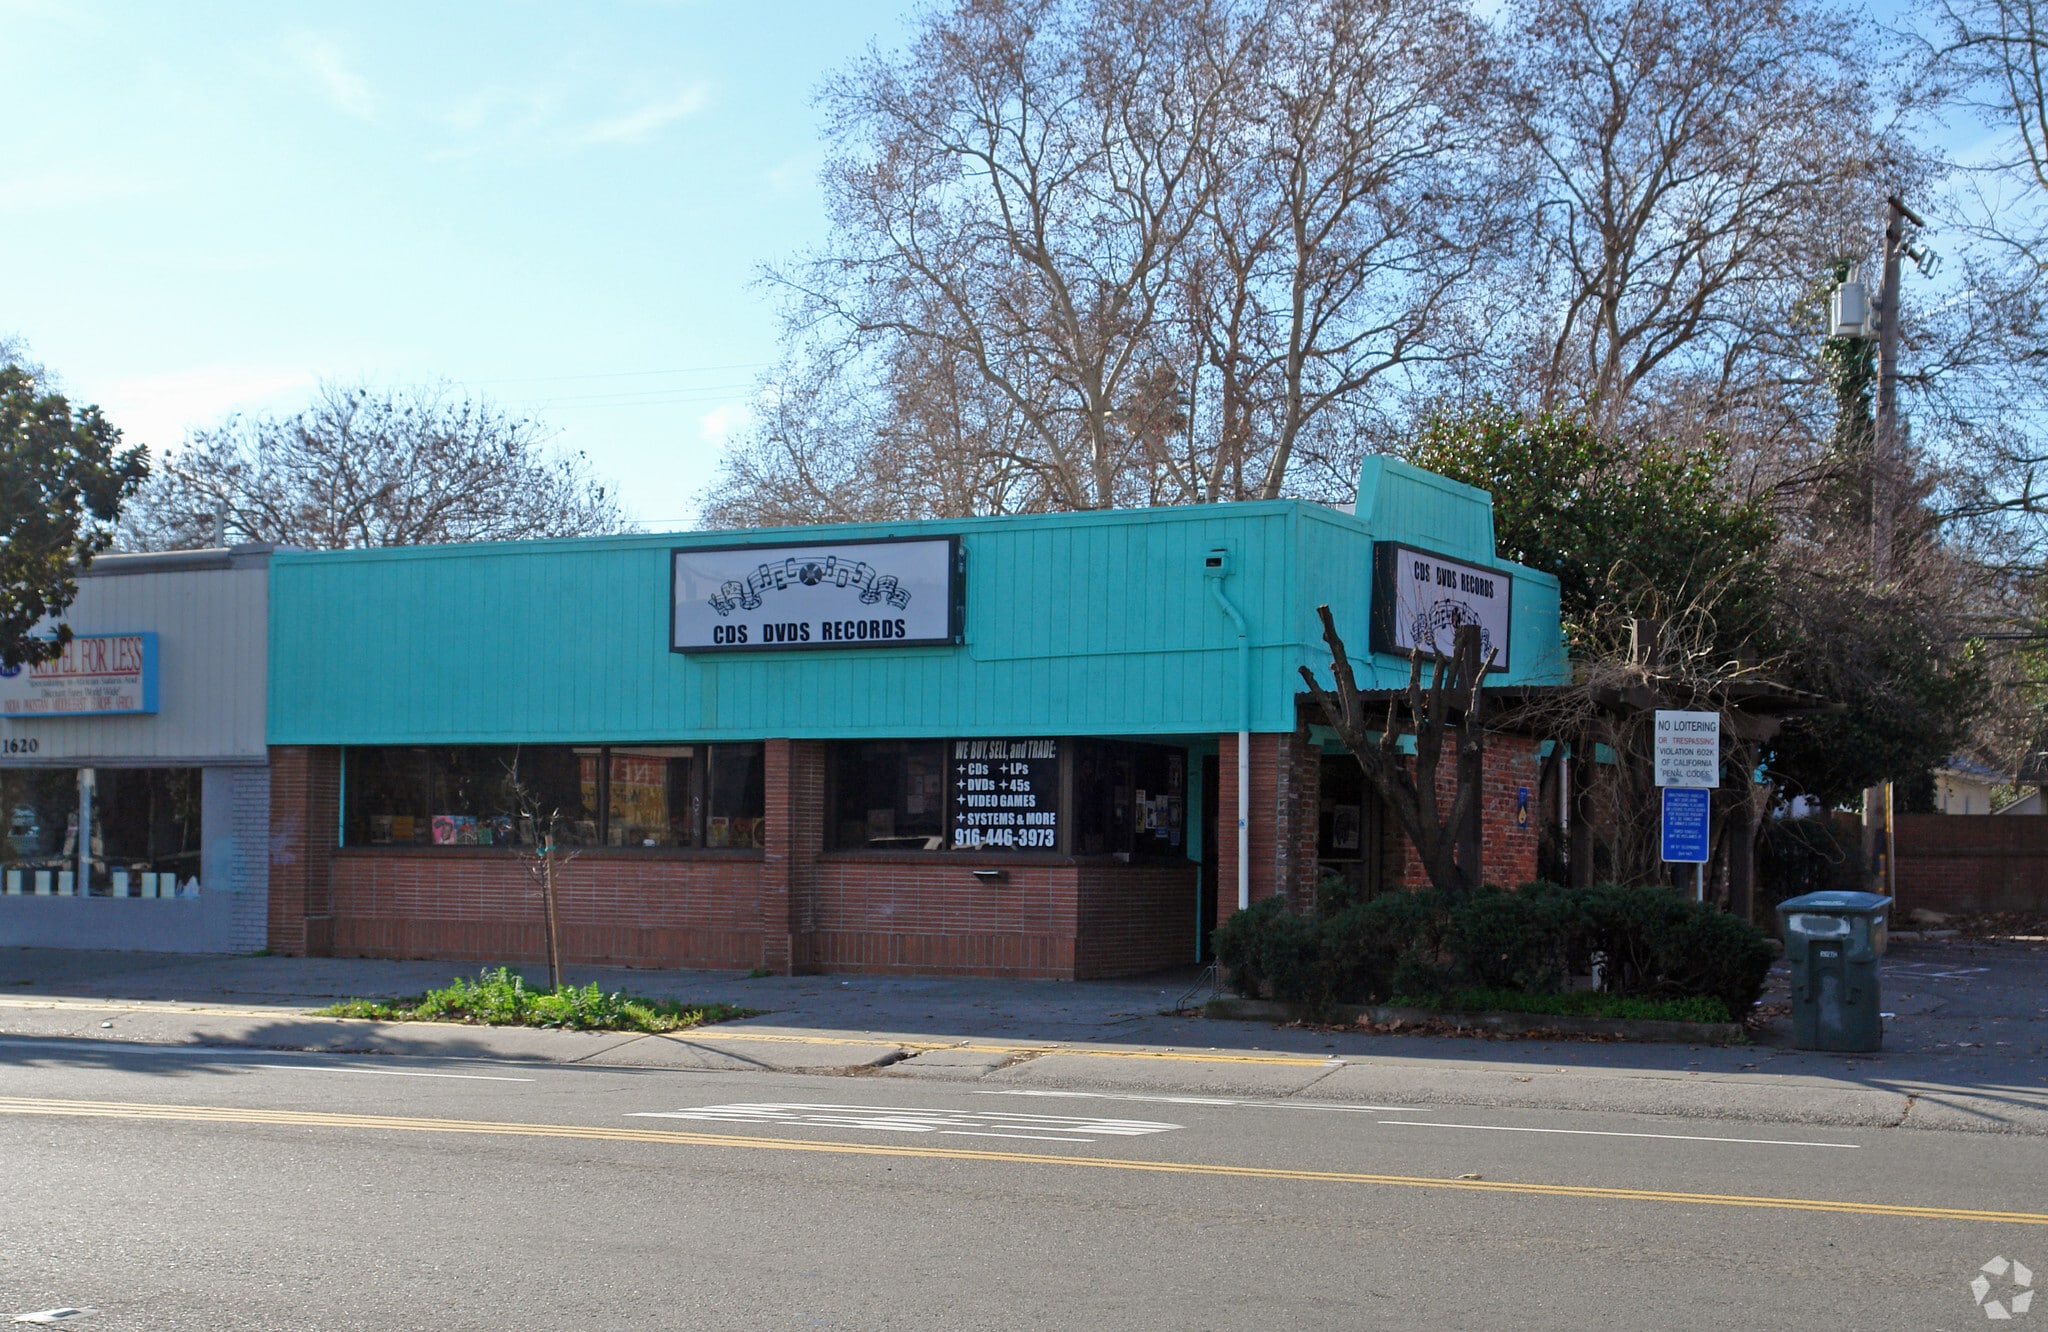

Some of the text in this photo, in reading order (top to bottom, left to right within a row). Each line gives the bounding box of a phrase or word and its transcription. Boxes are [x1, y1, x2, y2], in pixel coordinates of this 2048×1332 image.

[1414, 561, 1494, 598] CDS DVDS RECORDS
[714, 619, 906, 644] CDS DVDS RECORDS
[81, 639, 107, 672] FOR
[112, 637, 142, 671] LESS
[1658, 721, 1716, 732] NO LOITERING
[3, 738, 38, 753] 1620
[1673, 737, 1714, 745] TRESPASSING
[955, 740, 1056, 760] WE BUY, SELL, and TRADE:
[968, 762, 1028, 775] CDs LPs
[968, 779, 1030, 792] DVDs 45s
[967, 794, 1035, 808] VIDEO GAMES
[967, 812, 1056, 825] SYSTEMS & MORE
[955, 829, 1054, 847] 916-446-3973
